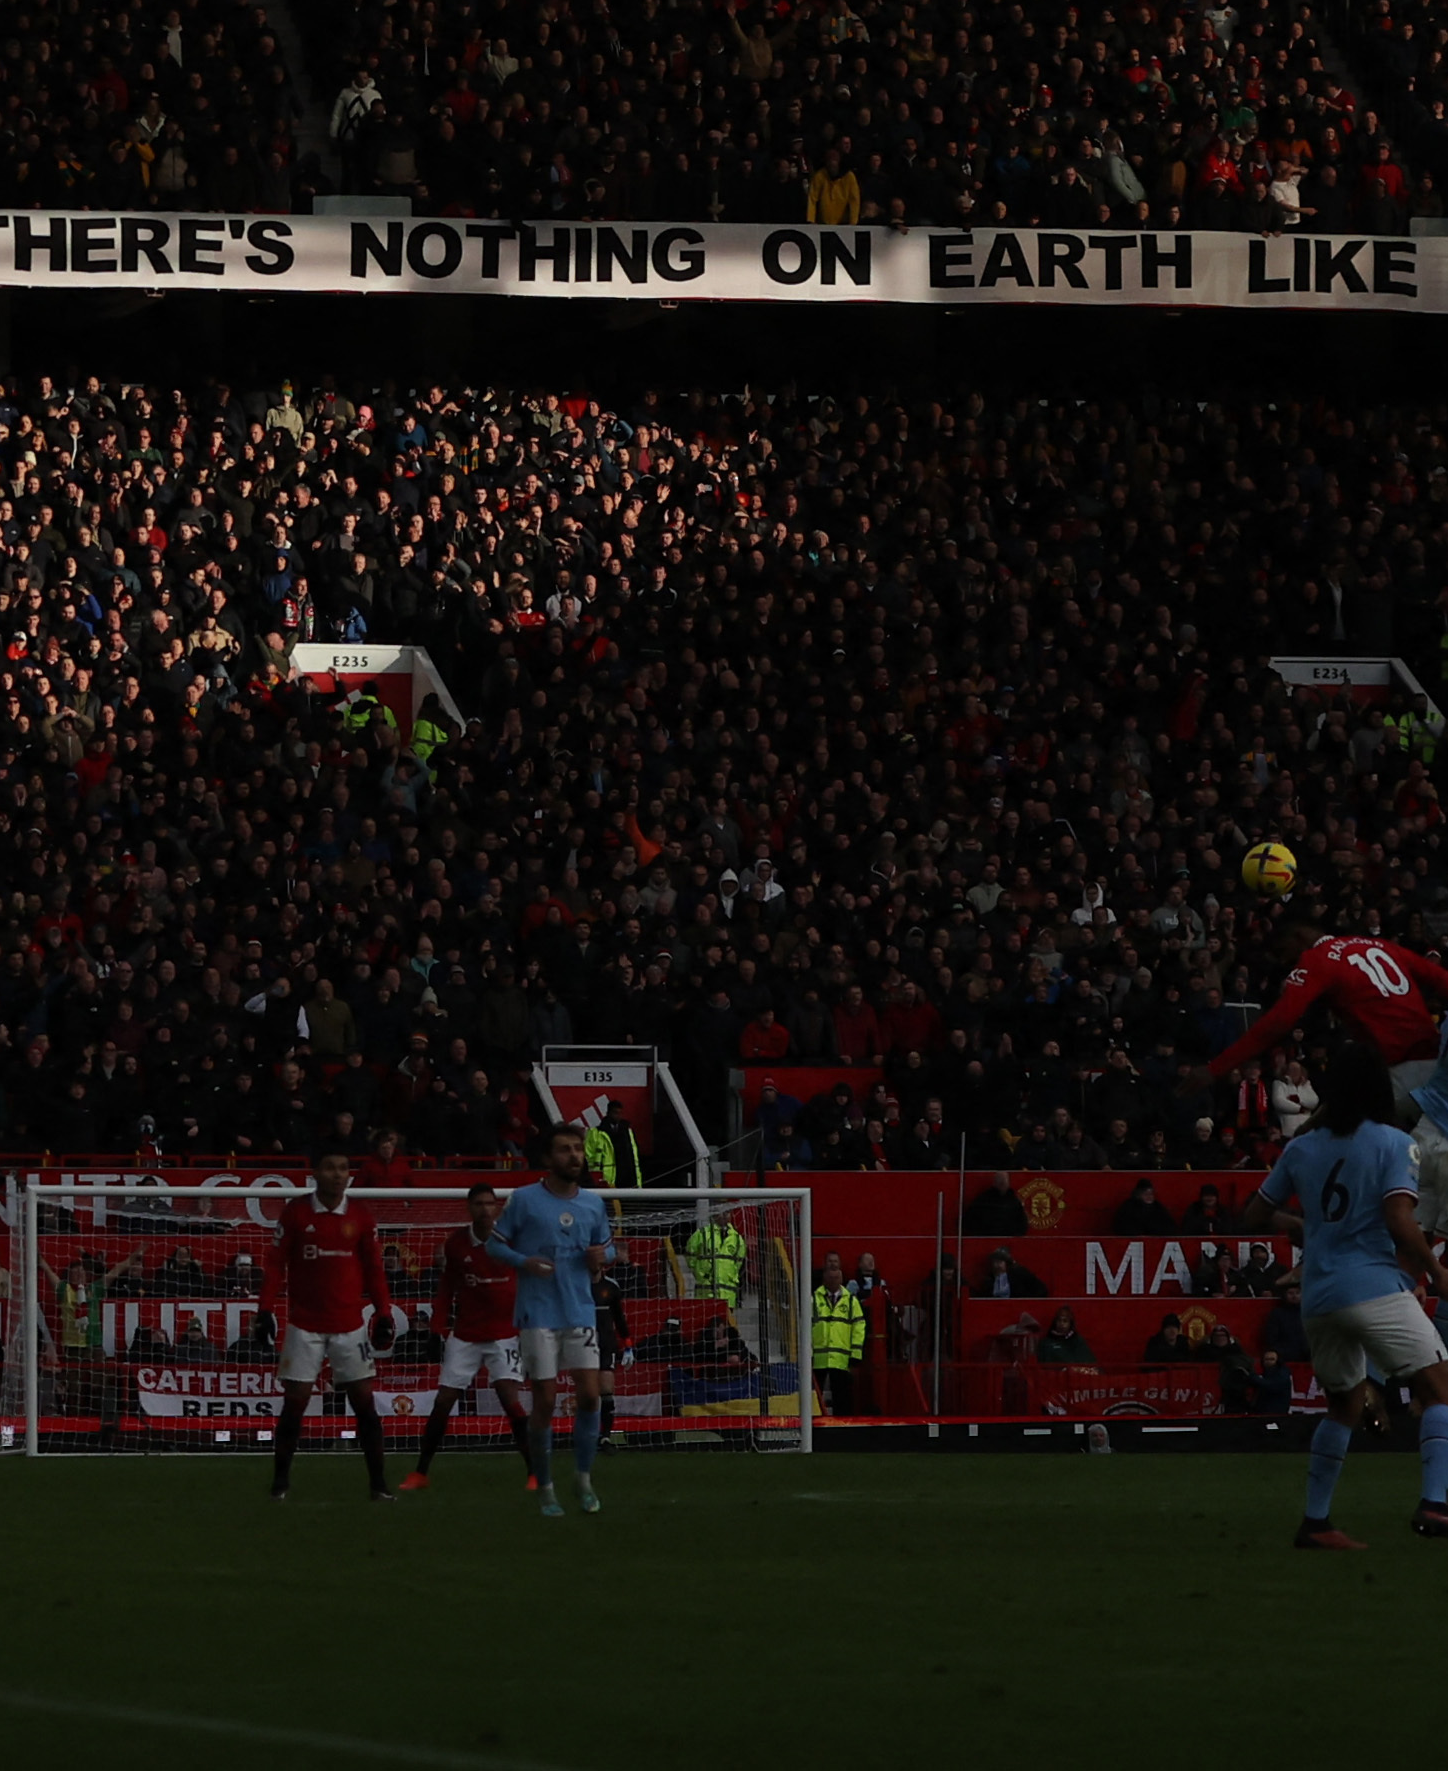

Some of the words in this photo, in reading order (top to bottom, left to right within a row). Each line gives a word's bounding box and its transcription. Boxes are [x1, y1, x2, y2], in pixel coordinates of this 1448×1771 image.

[349, 221, 707, 284] NOTHING
[761, 228, 872, 288] ON
[928, 231, 1193, 291] EARTH
[1247, 236, 1419, 298] LIKE
[332, 656, 369, 668] E235
[1313, 668, 1348, 680] E234
[1346, 946, 1411, 998] 10
[584, 1071, 613, 1082] E135
[1321, 1157, 1350, 1223] 6
[505, 1348, 520, 1365] 19
